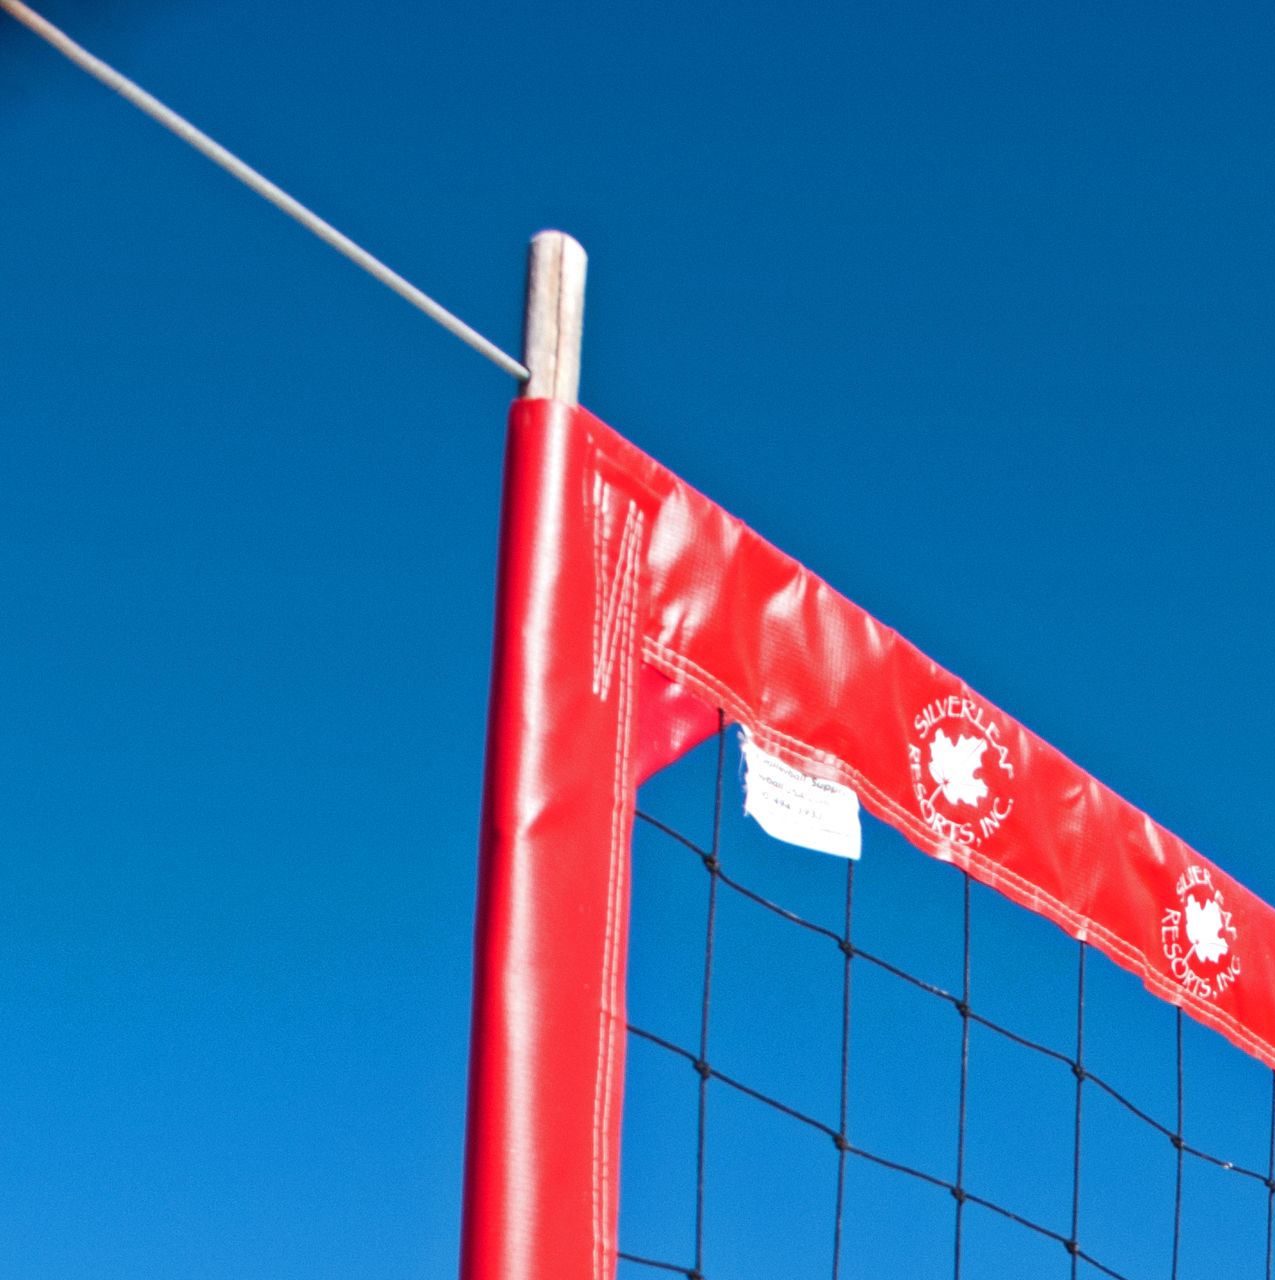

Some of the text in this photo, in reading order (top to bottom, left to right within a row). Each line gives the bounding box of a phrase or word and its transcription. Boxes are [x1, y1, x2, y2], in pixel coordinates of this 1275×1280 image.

[914, 695, 1014, 779] SILVERLEAF
[1176, 866, 1237, 940] SILVEREAF
[1161, 907, 1217, 999] RESORTS,
